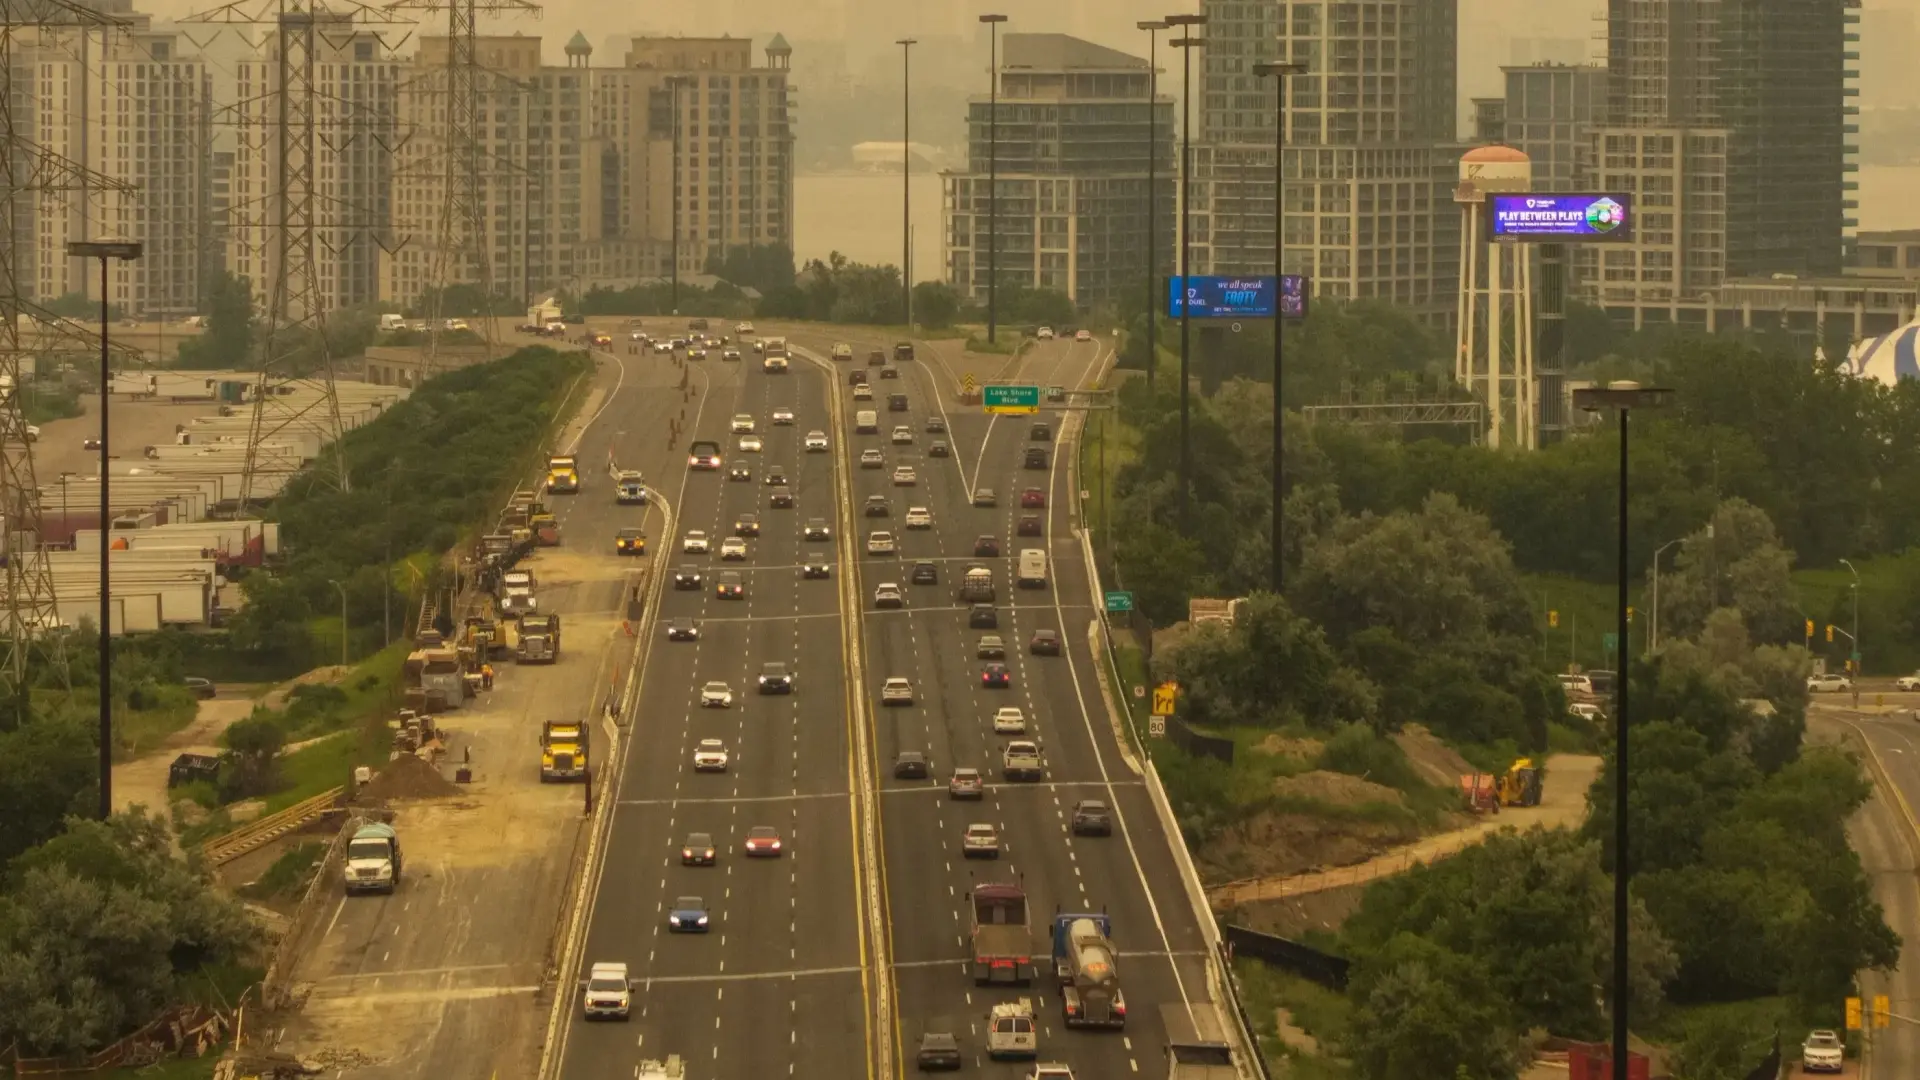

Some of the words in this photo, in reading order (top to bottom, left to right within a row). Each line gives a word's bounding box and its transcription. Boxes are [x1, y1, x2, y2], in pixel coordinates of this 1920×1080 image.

[1499, 211, 1518, 221] PLAY
[1521, 211, 1557, 221] BETWEEN
[1559, 211, 1583, 221] PLAYS
[1229, 279, 1240, 289] all
[1241, 279, 1263, 290] speak
[1225, 291, 1257, 304] FOOTY
[1150, 722, 1164, 732] 80
